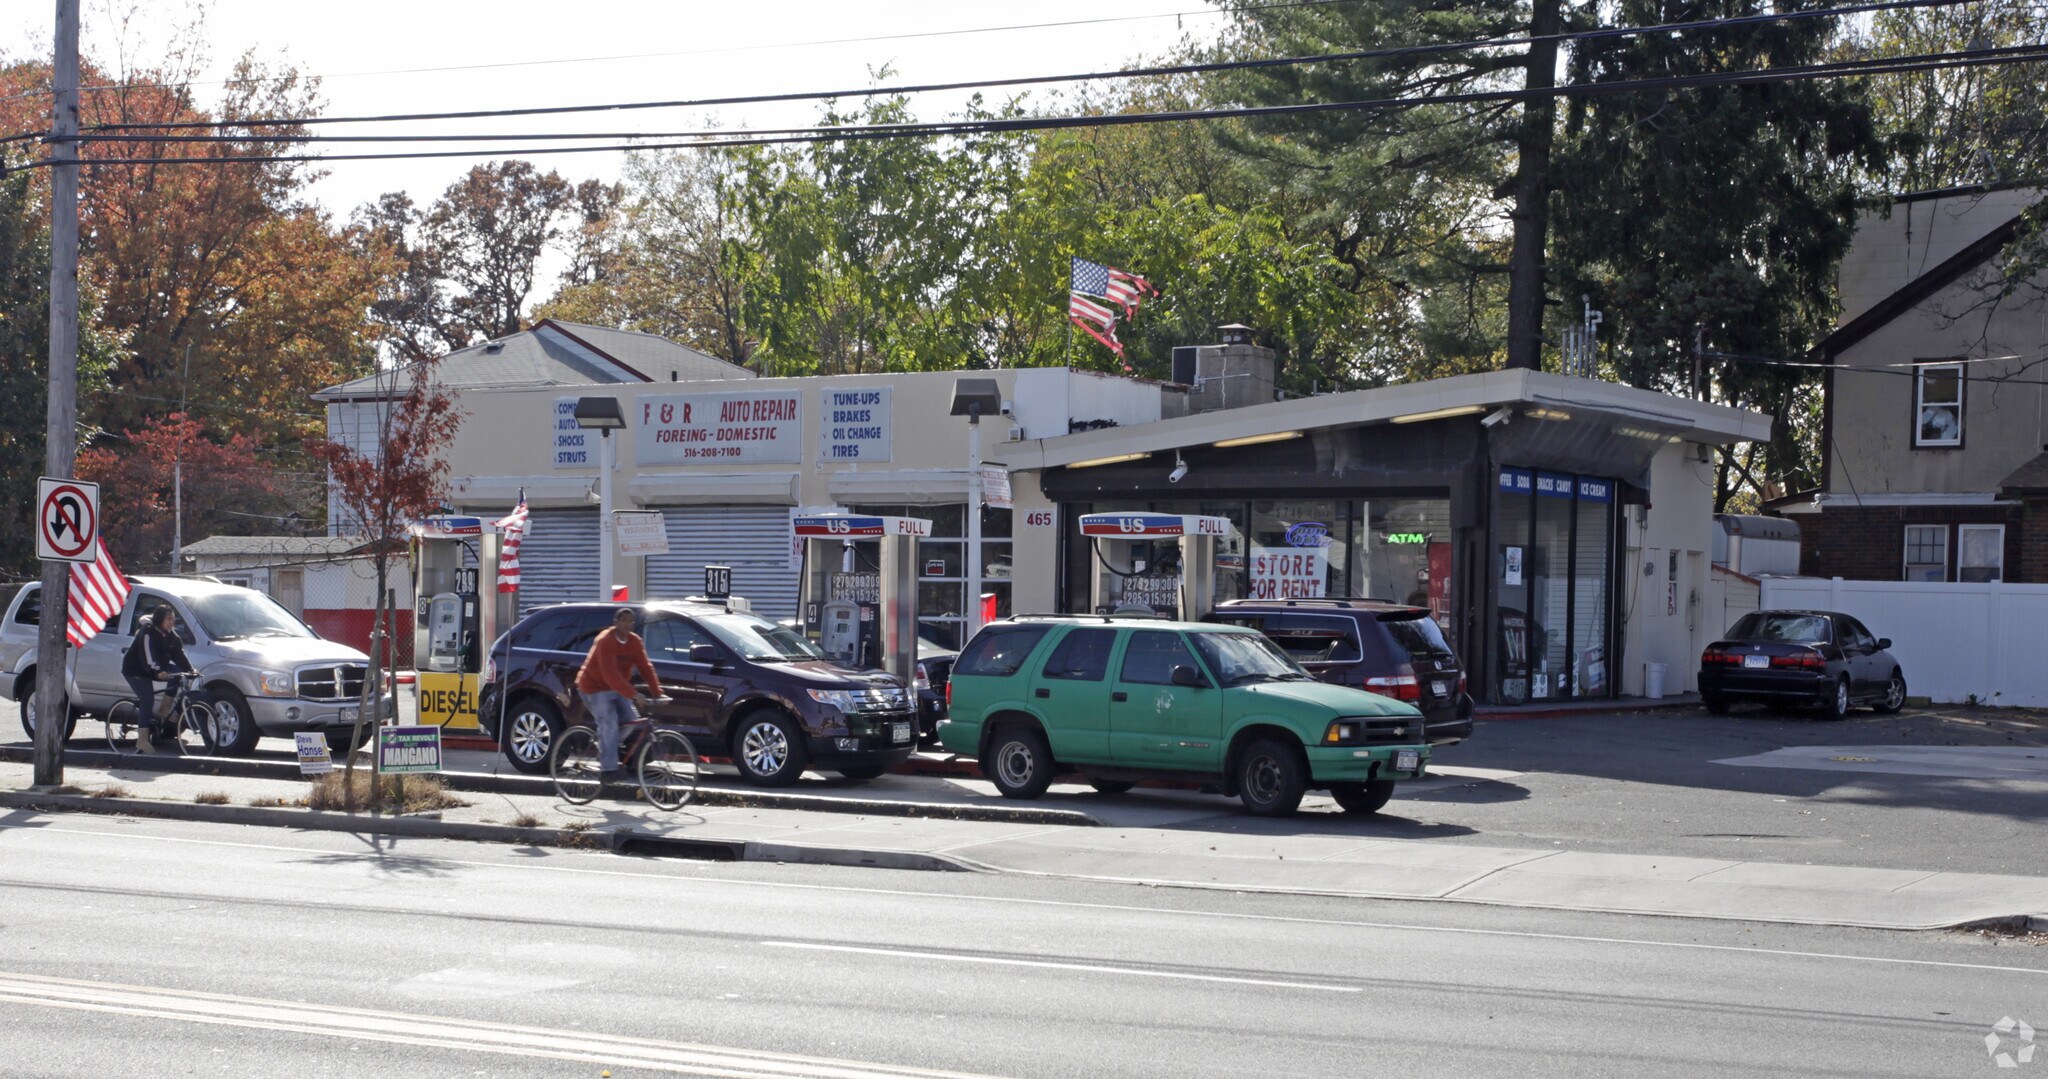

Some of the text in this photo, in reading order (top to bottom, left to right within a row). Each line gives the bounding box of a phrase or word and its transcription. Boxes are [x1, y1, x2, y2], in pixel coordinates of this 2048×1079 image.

[833, 392, 880, 406] TUNE-UPS
[644, 399, 797, 425] F & R AUTO REPAIR
[833, 410, 871, 423] BRAKES
[558, 418, 576, 431] AUTO
[656, 428, 707, 443] FOREING
[716, 426, 777, 441] DOMESTIC
[832, 426, 882, 440] OIL CHANGE
[558, 434, 585, 447] SHOCKS
[558, 451, 587, 464] STRUTS
[684, 447, 741, 458] 516-208-7100
[832, 444, 859, 458] TIRES
[1517, 474, 1530, 489] SODA
[1537, 477, 1572, 493] SNACKS CANDY
[1580, 482, 1606, 497] ICE CREAM
[433, 520, 454, 533] US
[1027, 513, 1052, 526] 465
[1118, 518, 1146, 533] US
[1199, 519, 1223, 534] FULL
[826, 520, 851, 534] US
[899, 520, 925, 535] FULL
[1387, 533, 1425, 544] ATM
[1257, 554, 1315, 577] STORE
[1161, 578, 1178, 591] 309
[1249, 578, 1321, 599] FOR RENT
[419, 598, 426, 614] 8
[1144, 592, 1160, 605] 315
[1161, 592, 1177, 606] 325
[808, 606, 817, 622] 4
[420, 689, 478, 715] DIESEL
[296, 735, 312, 744] Steve
[412, 734, 435, 742] REVOLT
[384, 747, 438, 766] MANGANO
